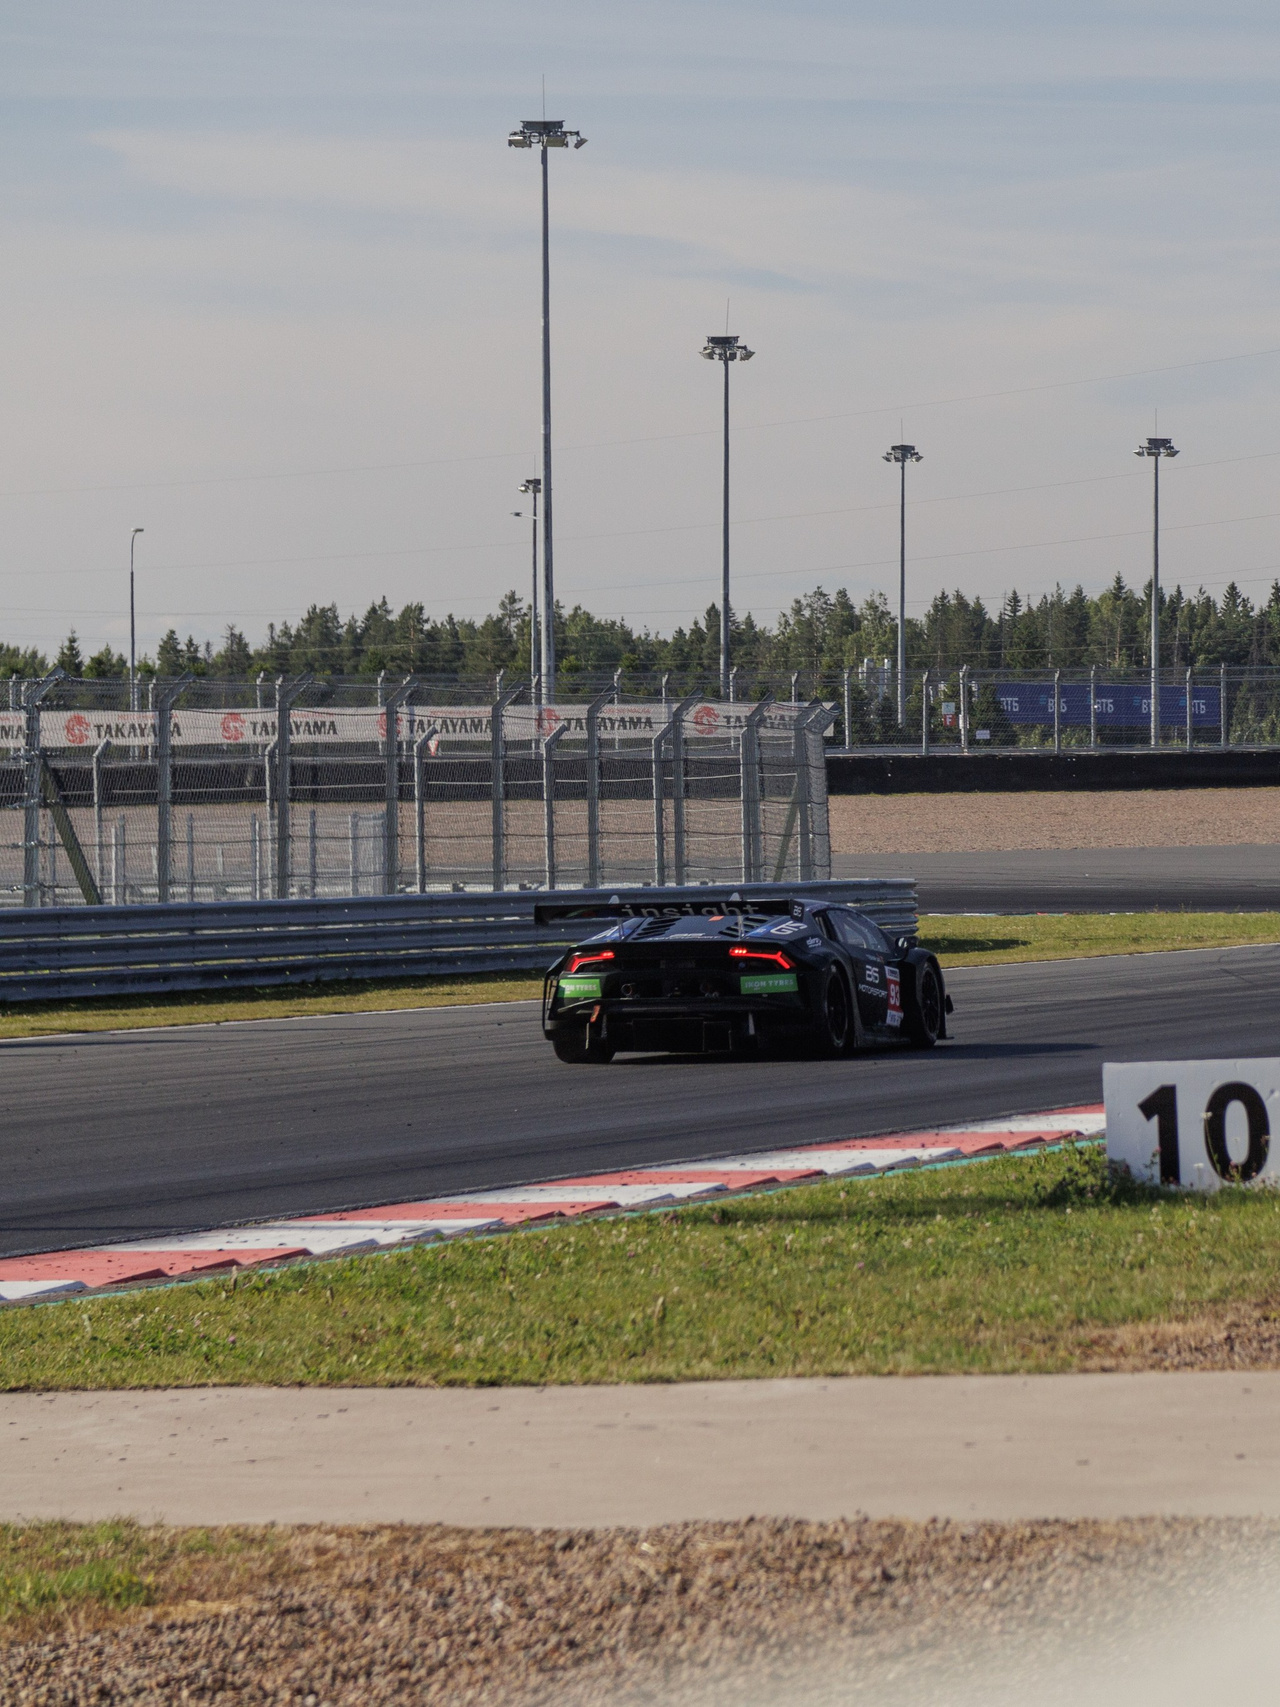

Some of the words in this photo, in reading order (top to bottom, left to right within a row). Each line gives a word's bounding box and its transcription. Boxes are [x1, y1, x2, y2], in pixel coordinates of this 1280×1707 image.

[1048, 698, 1067, 712] ВБ
[1095, 699, 1114, 713] ВТБ
[94, 722, 182, 739] TAKAYAA
[564, 717, 653, 731] TAAYAMA
[858, 983, 888, 999] MOTORSPORT
[890, 983, 900, 1006] 93
